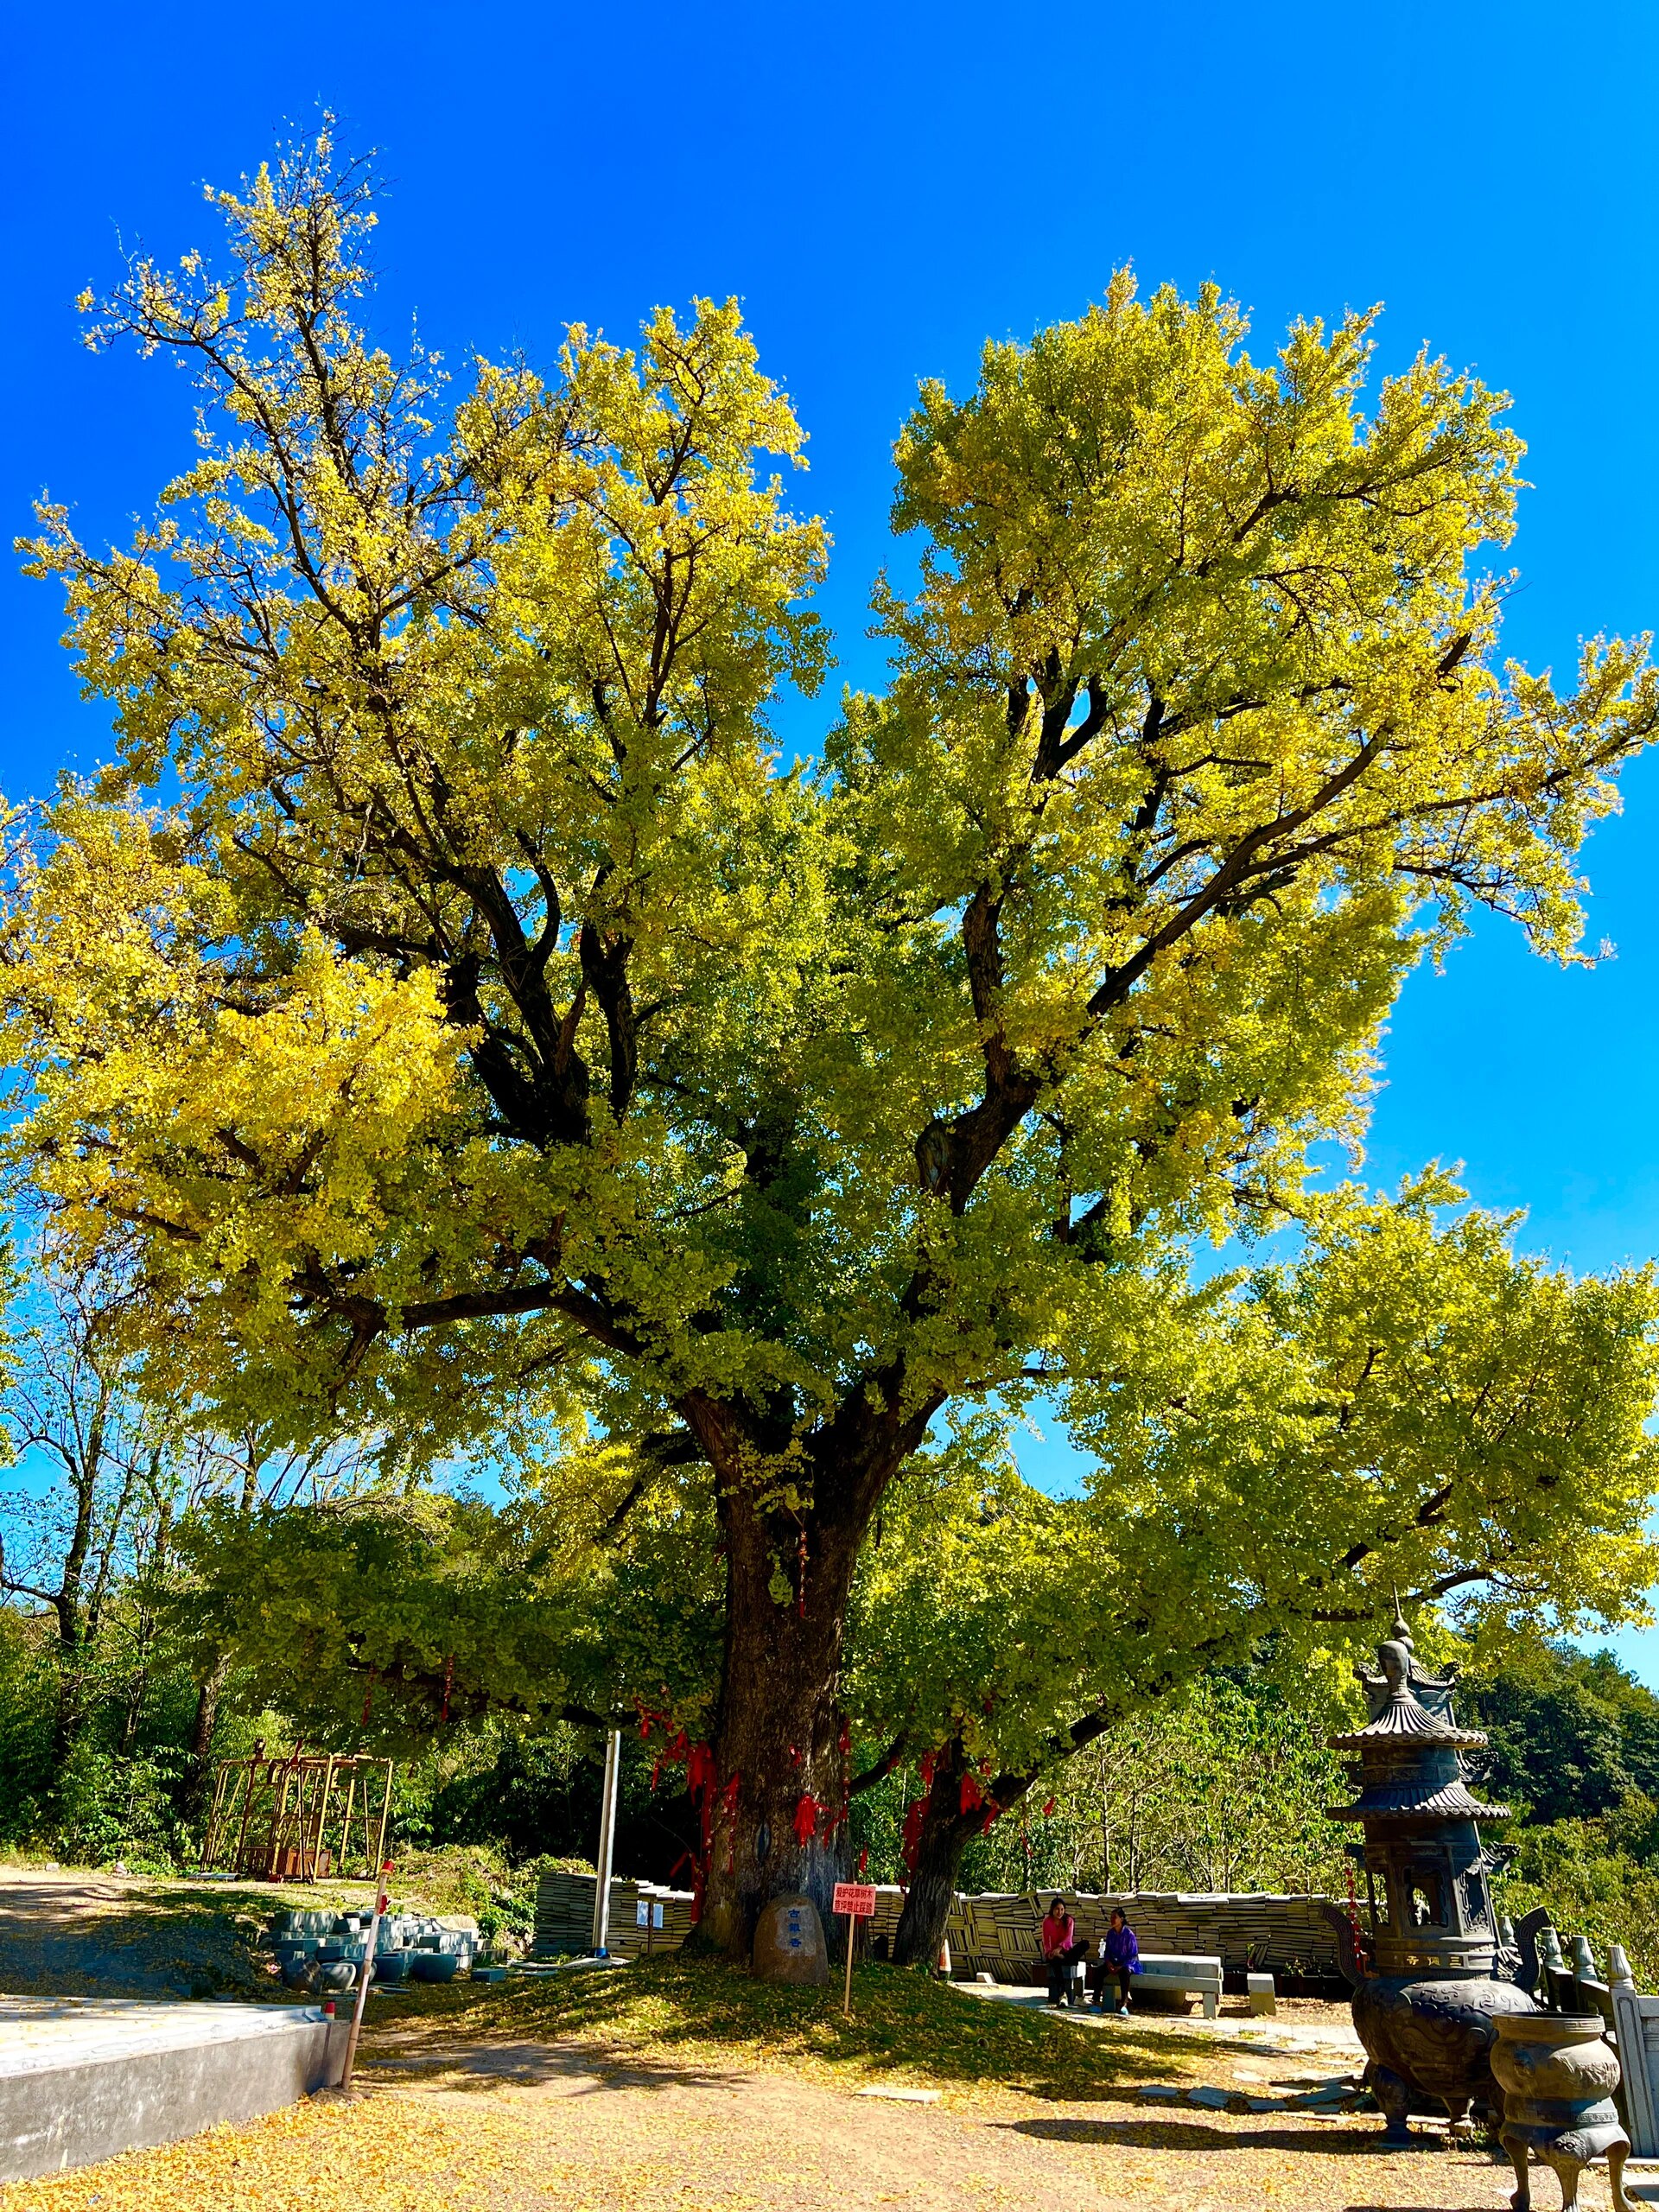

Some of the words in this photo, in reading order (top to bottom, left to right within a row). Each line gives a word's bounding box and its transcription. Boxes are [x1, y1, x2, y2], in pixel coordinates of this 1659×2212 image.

[836, 1886, 873, 1899] 爱护花草树木
[834, 1900, 873, 1914] 草坪禁止踩踏
